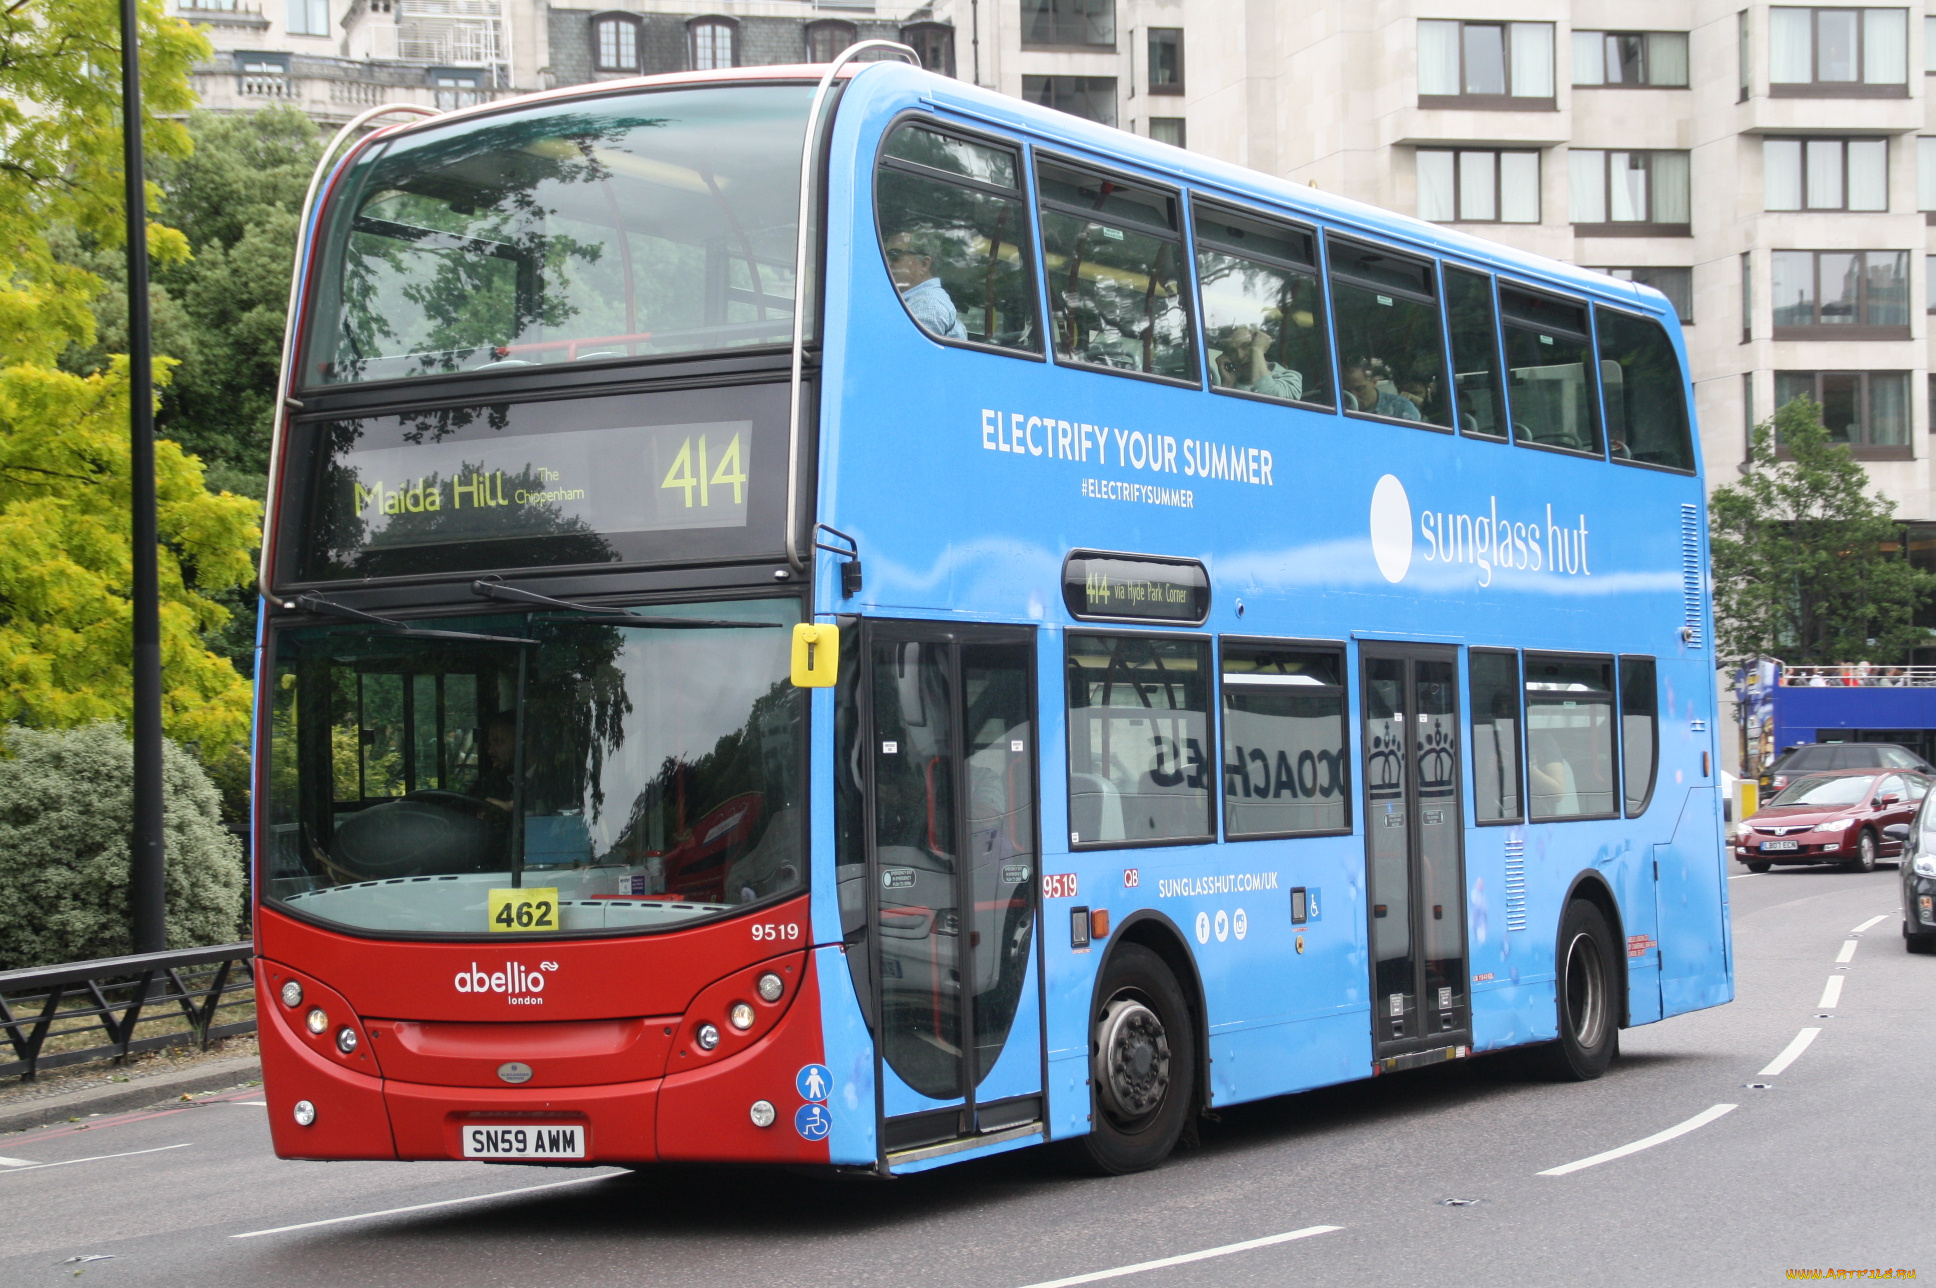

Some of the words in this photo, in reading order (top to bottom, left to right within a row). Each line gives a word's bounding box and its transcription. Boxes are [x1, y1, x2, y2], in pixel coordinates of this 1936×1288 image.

[982, 409, 1108, 464] ELECTRIFY
[1114, 428, 1177, 473] YOUR
[1183, 438, 1273, 486] SUMMER
[538, 467, 560, 482] The
[661, 432, 746, 507] 414
[354, 477, 440, 517] Maida
[453, 471, 508, 509] Hill
[514, 486, 585, 507] Chippenham
[1081, 478, 1194, 508] #ELECTRIFYSUMMER
[1421, 495, 1541, 588] sunglass
[1546, 503, 1591, 576] hut
[1086, 572, 1110, 604] 414
[1114, 583, 1125, 599] via
[1127, 580, 1145, 606] Hyde
[1147, 581, 1163, 602] Park
[1165, 584, 1187, 603] Corner
[1043, 873, 1077, 898] 9519
[1124, 869, 1139, 887] QB
[1159, 872, 1279, 898] SUNGLASSHUT.COM/UK
[495, 901, 552, 928] 462
[751, 923, 799, 941] 9519
[454, 962, 544, 994] abellio
[508, 996, 543, 1005] london
[472, 1130, 527, 1153] SN59
[534, 1130, 576, 1153] AWM
